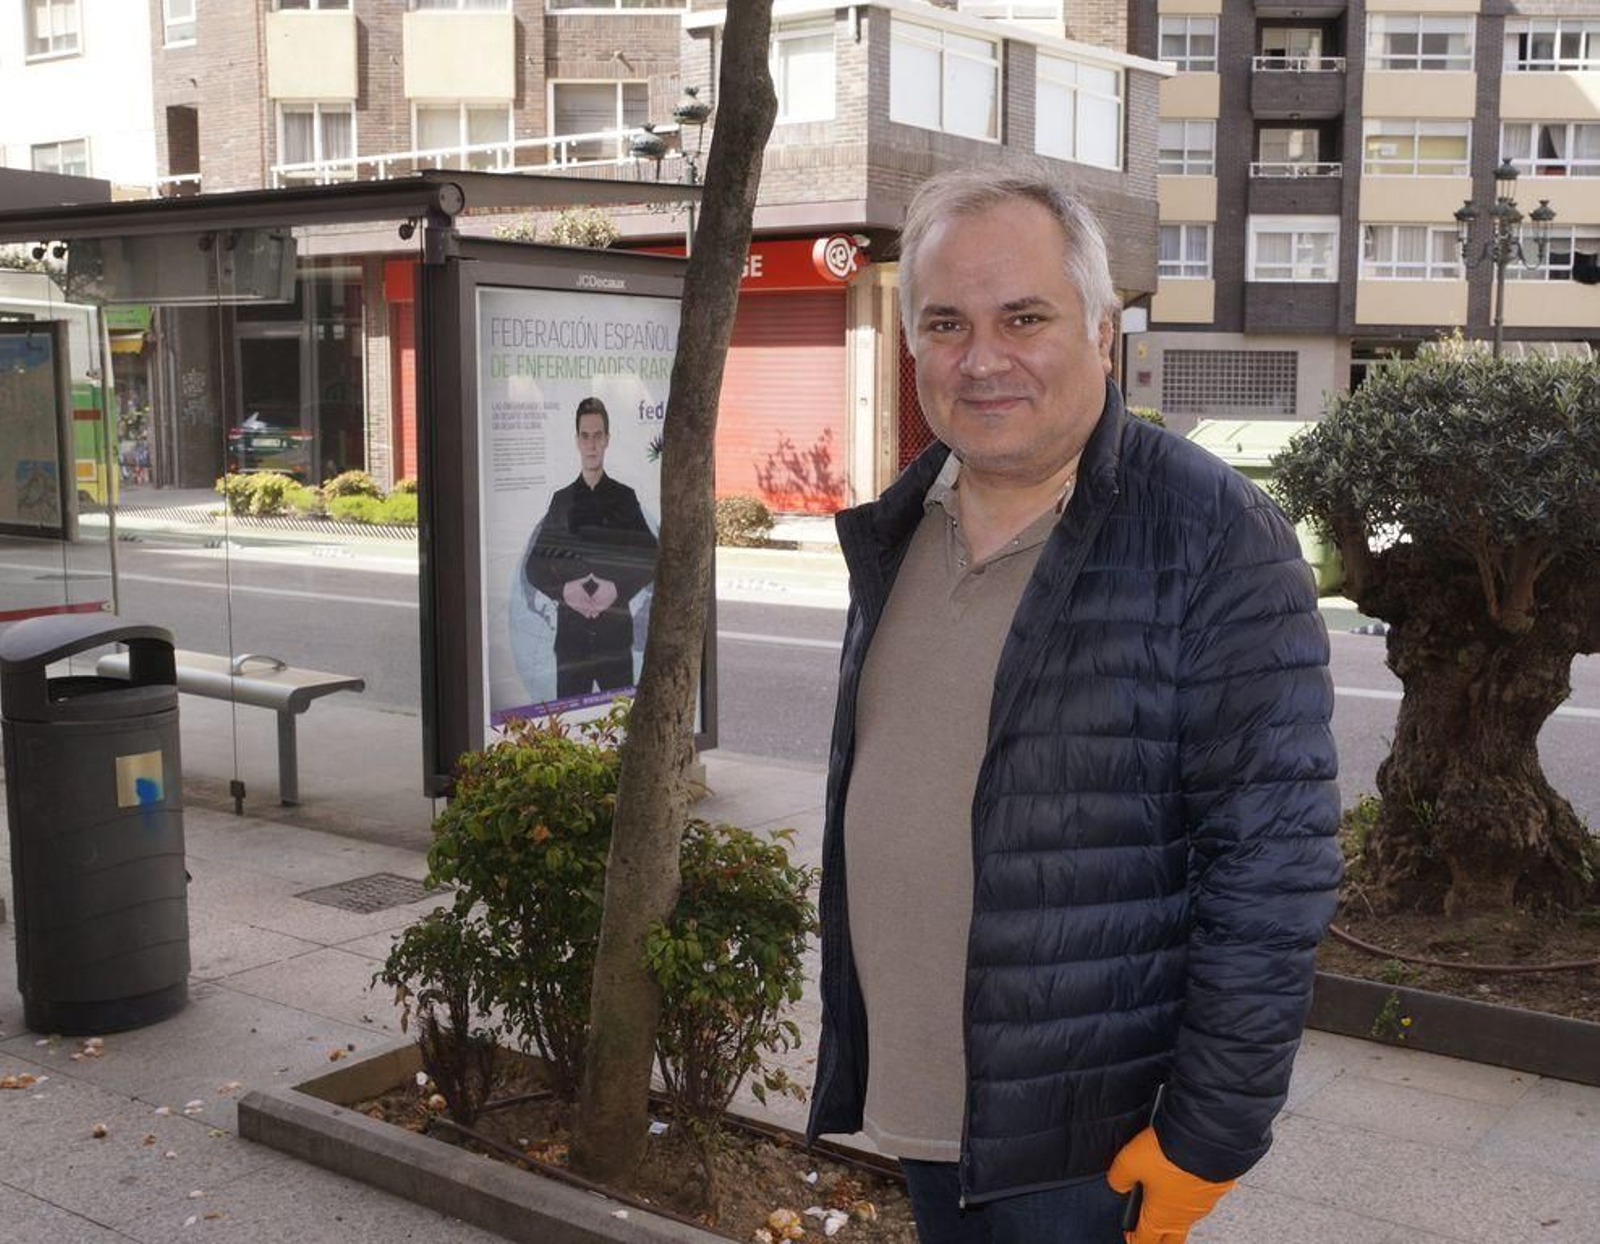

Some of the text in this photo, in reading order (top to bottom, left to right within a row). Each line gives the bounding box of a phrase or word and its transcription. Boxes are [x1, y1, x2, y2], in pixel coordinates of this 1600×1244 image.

[576, 274, 626, 289] JCDecaux
[491, 316, 675, 352] FEDERACIÓN ESPAÑOL
[491, 354, 675, 380] DE ENFERMEDADES RAR
[639, 400, 665, 420] fed
